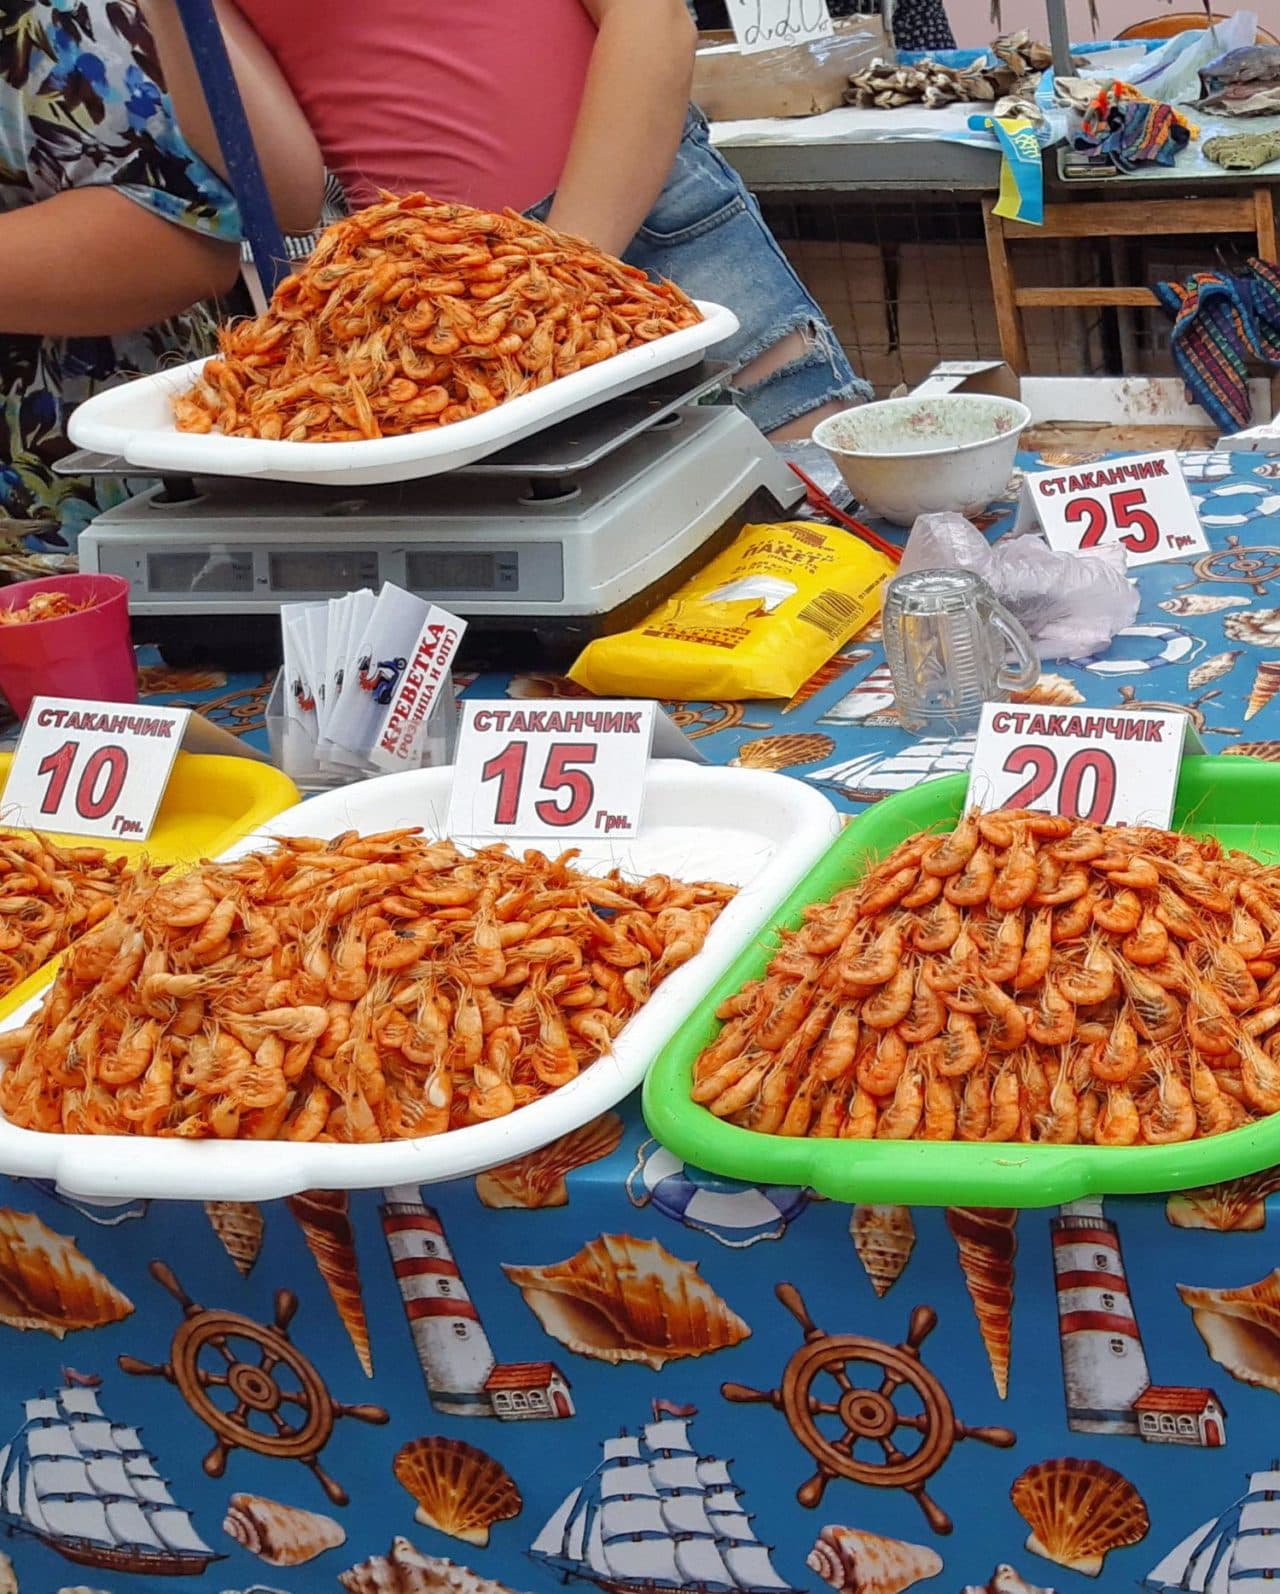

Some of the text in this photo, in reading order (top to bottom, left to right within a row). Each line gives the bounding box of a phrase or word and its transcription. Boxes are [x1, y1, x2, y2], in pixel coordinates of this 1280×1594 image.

[1038, 458, 1170, 497] СТАКАНЧИК
[1064, 487, 1161, 553] 25
[1165, 533, 1198, 552] Грн.
[435, 628, 458, 666] ОПТ)
[380, 622, 446, 754] КРЕВЕТКА
[37, 708, 176, 738] СТАКАНЧИК
[472, 710, 643, 734] СТАКАНЧИК
[991, 711, 1165, 743] СТАКАНЧИК
[37, 740, 130, 821] 10
[481, 740, 599, 828] 15
[987, 743, 1118, 826] 20
[111, 814, 144, 835] Грн.
[594, 810, 633, 834] Грн.
